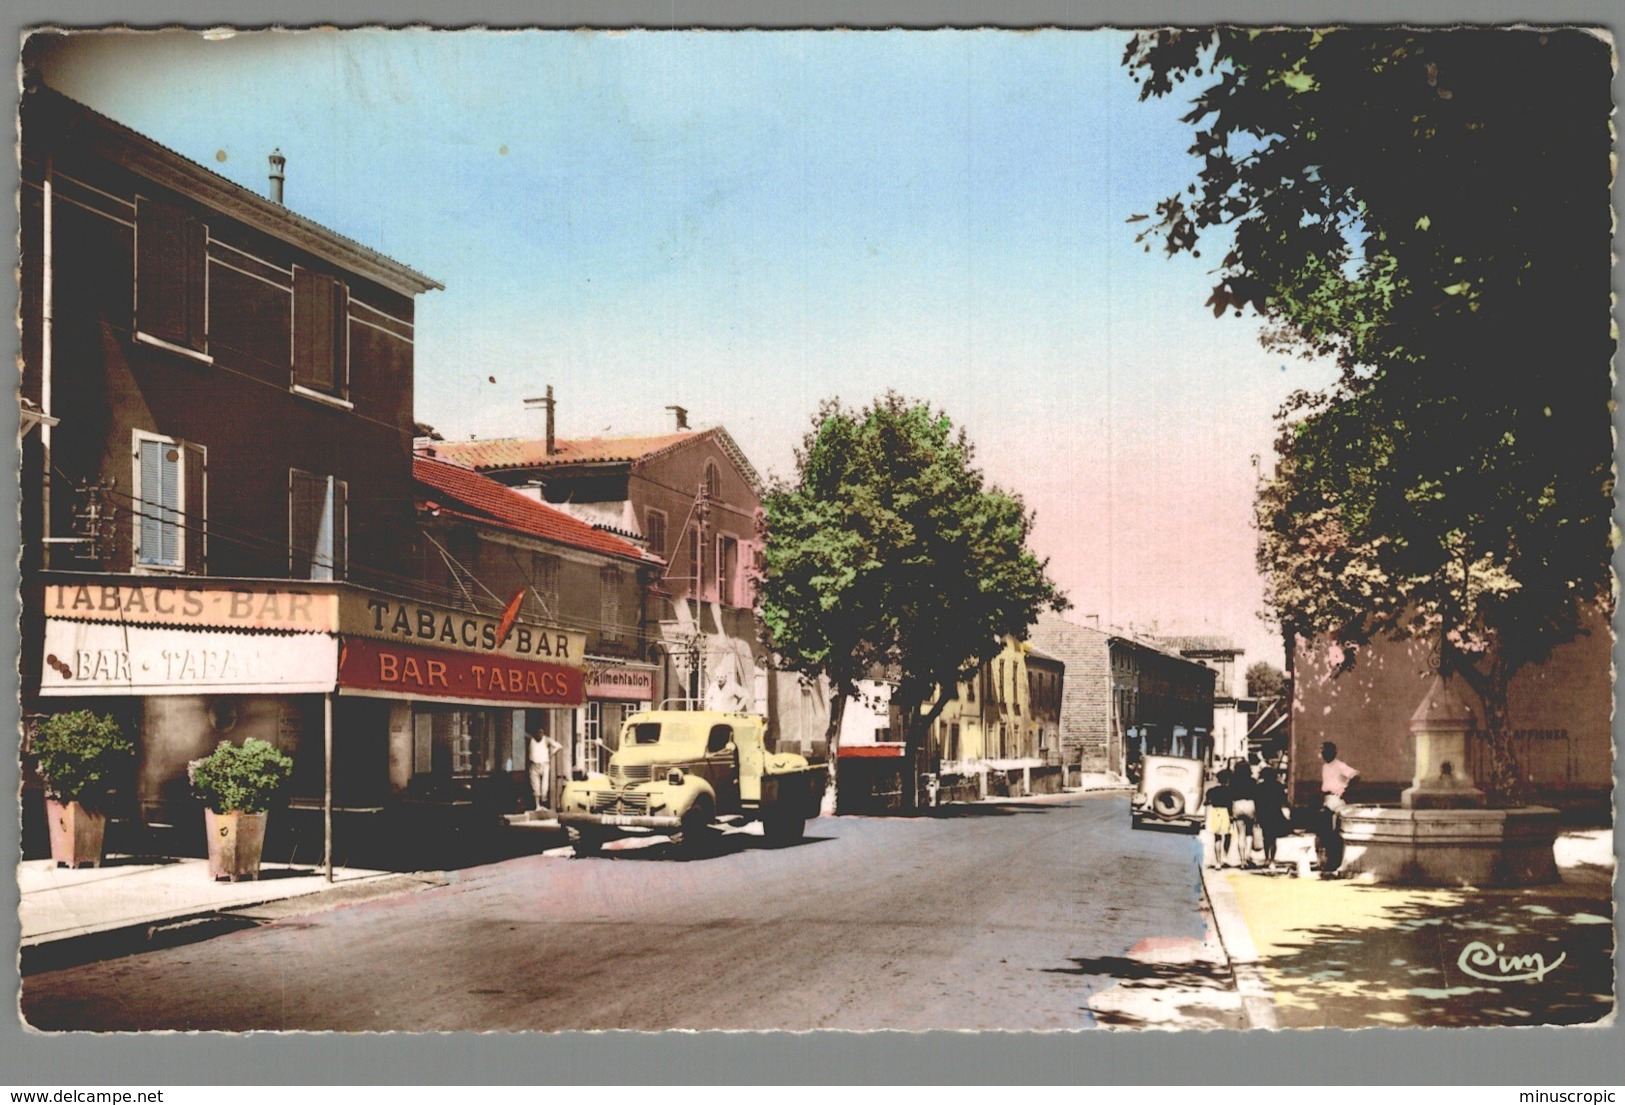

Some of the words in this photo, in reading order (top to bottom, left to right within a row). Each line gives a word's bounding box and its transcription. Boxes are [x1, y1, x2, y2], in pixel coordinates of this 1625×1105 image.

[228, 589, 314, 622] BAR
[367, 599, 496, 650] TABACS
[516, 628, 569, 659] BAR
[75, 649, 132, 682] BAR
[378, 652, 449, 688] BAR
[471, 665, 568, 697] TABACS
